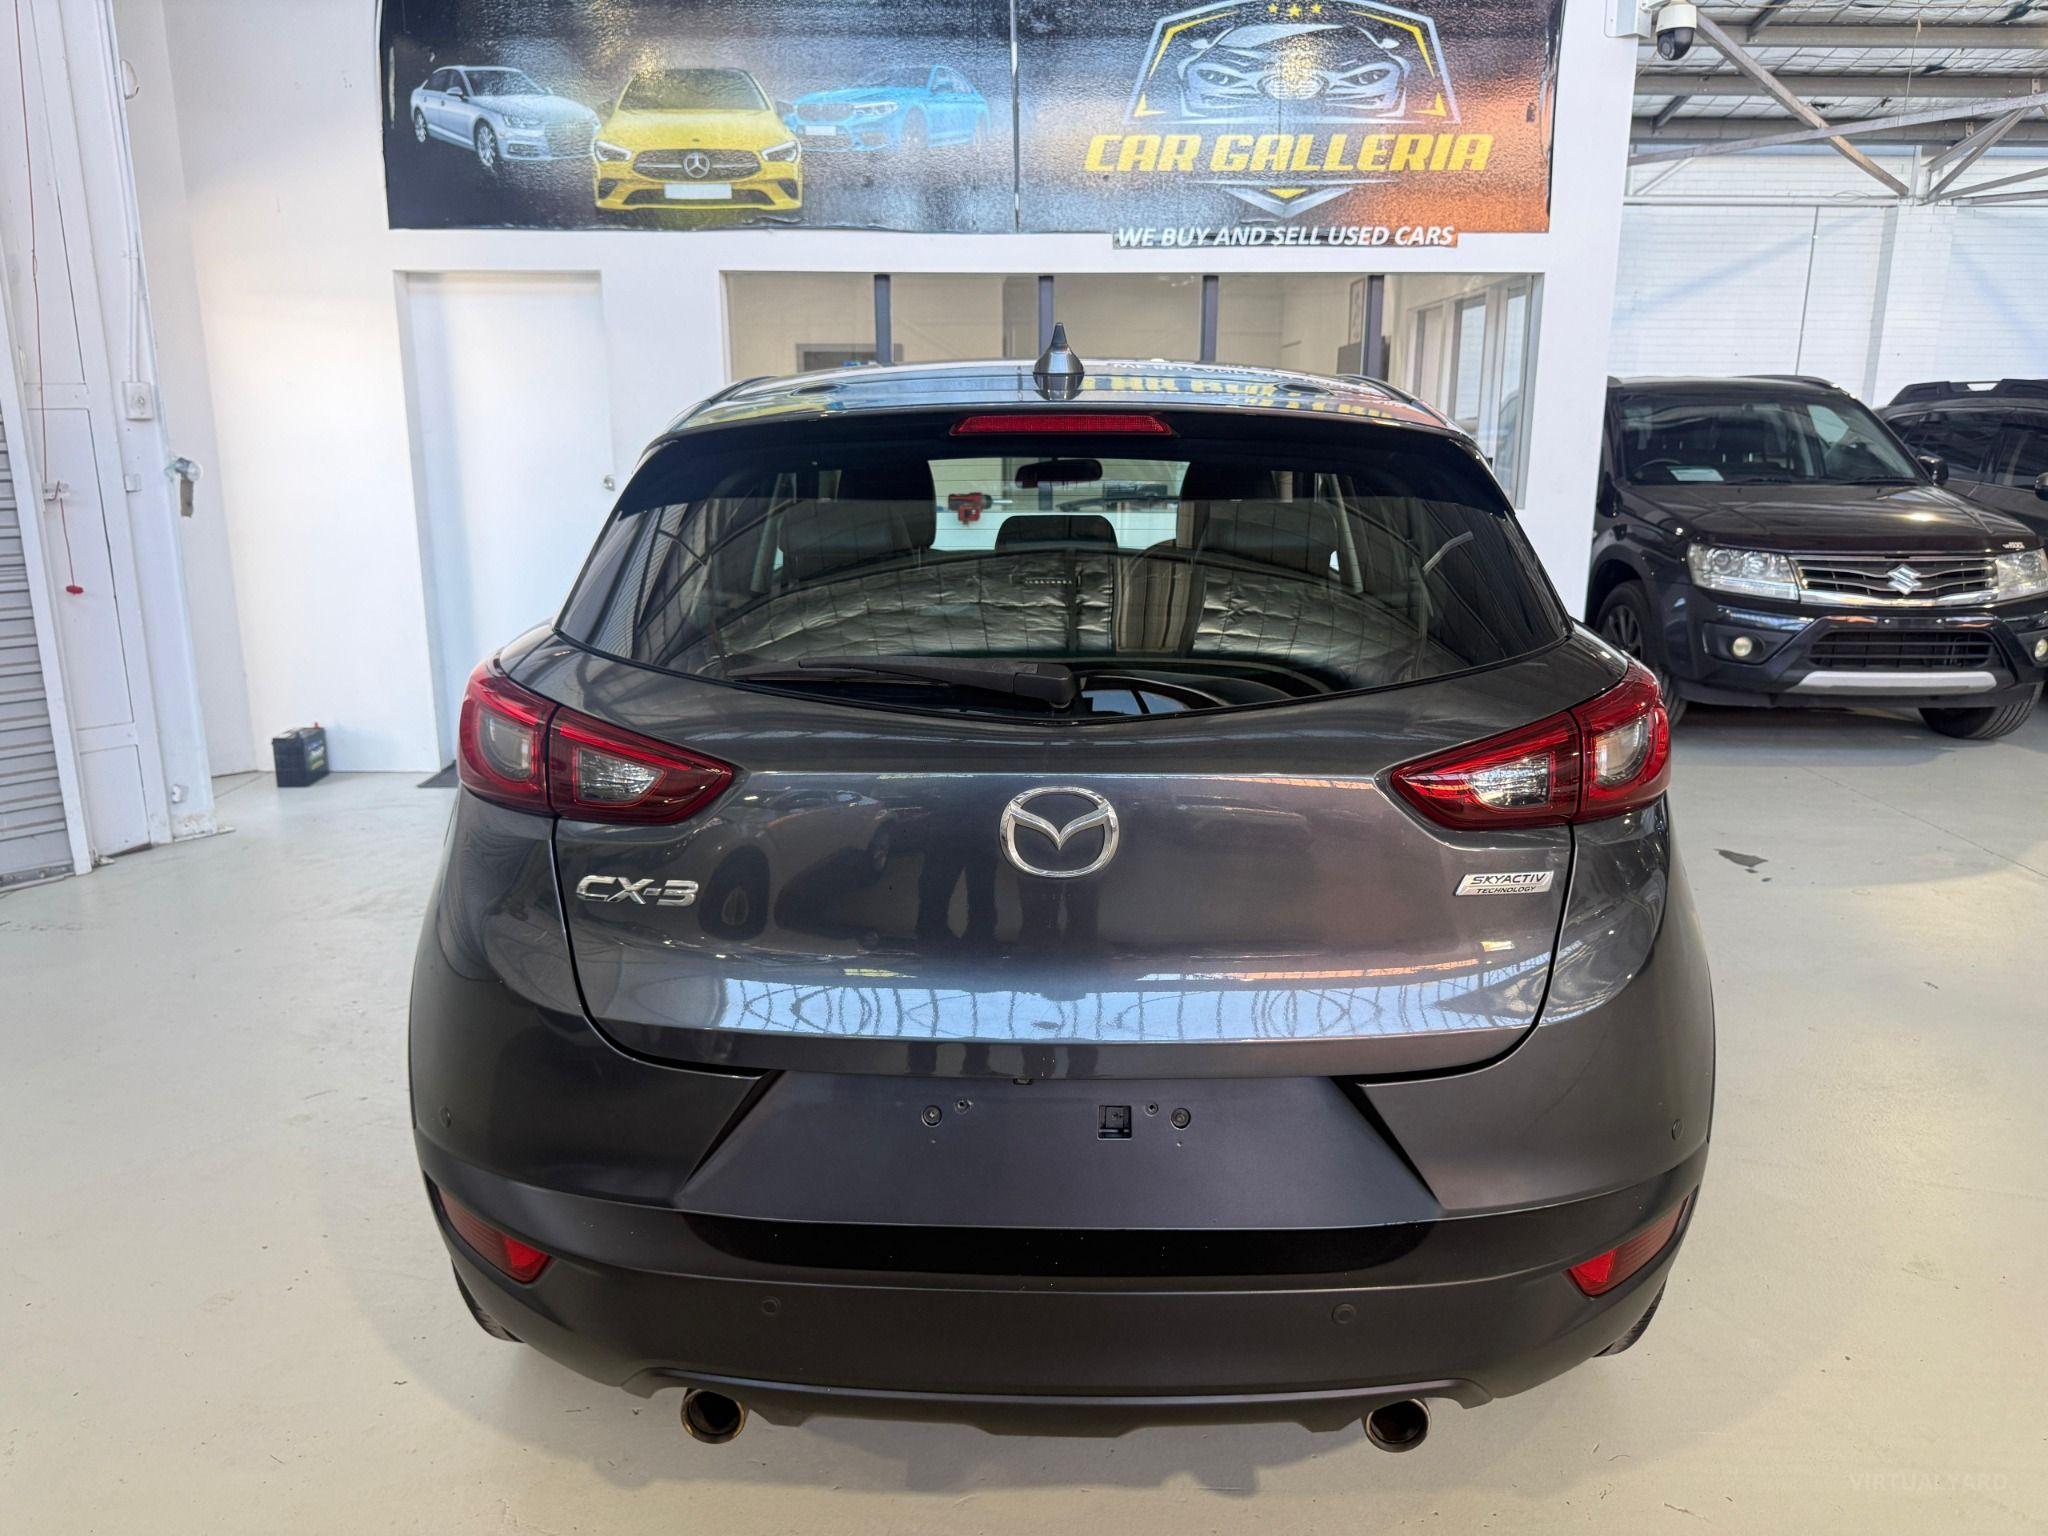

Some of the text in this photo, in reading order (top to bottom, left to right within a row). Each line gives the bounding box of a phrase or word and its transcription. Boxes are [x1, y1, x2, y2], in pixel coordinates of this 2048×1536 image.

[1084, 133, 1494, 172] CAR GALLERIA
[1118, 225, 1456, 247] WE BUY AND SELL USED CARS
[576, 874, 699, 906] CX-3
[1470, 873, 1546, 885] SKYACTIV
[1476, 886, 1536, 894] TECHNOLOGY
